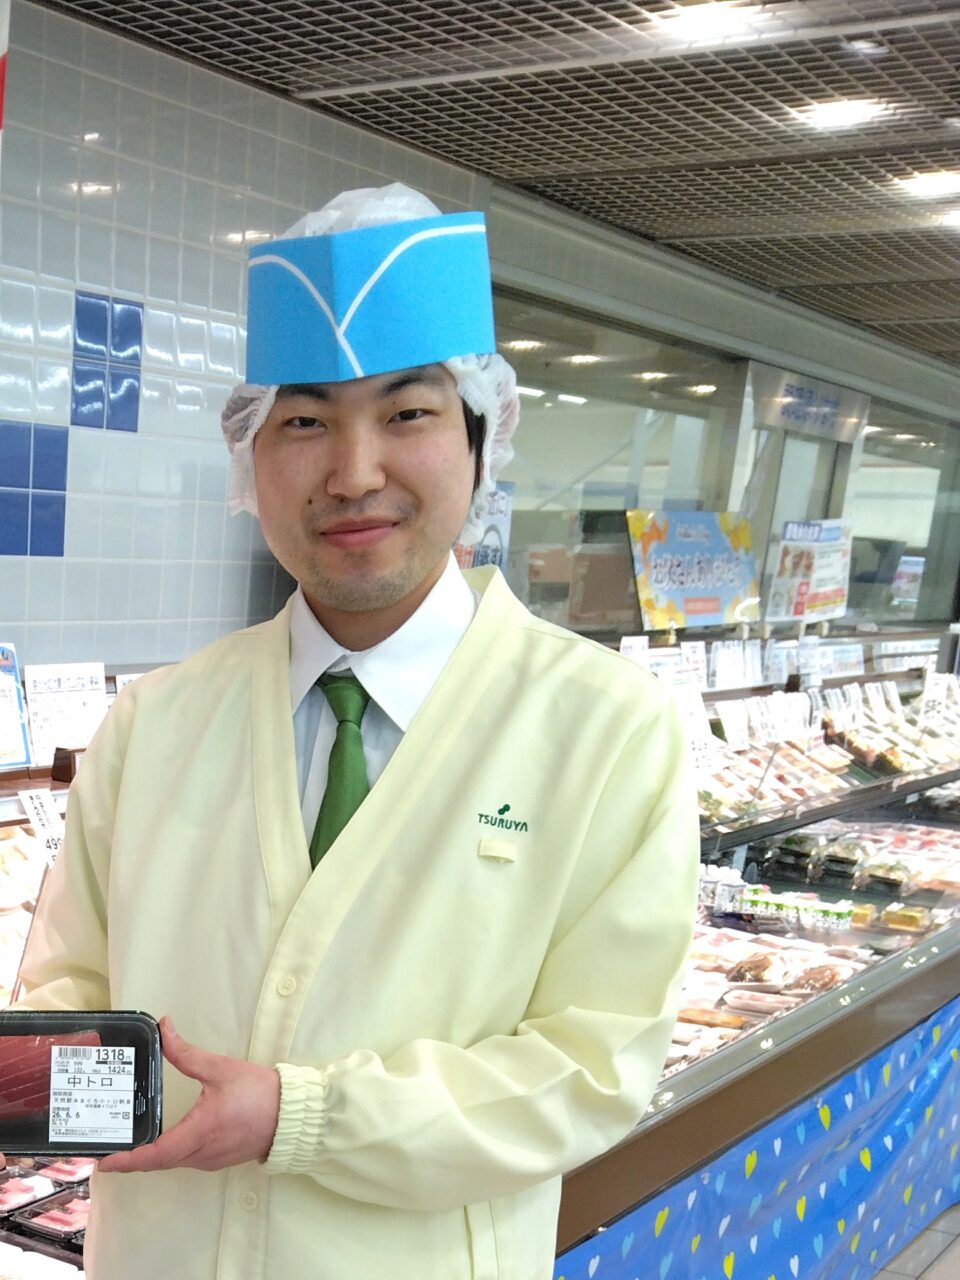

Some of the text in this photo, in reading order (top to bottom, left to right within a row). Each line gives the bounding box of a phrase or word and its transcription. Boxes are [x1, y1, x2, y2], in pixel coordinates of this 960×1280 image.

[478, 813, 528, 832] TSURUYA
[95, 1048, 125, 1061] 1318
[108, 1066, 126, 1074] 1424
[67, 1075, 113, 1088] 中トロ
